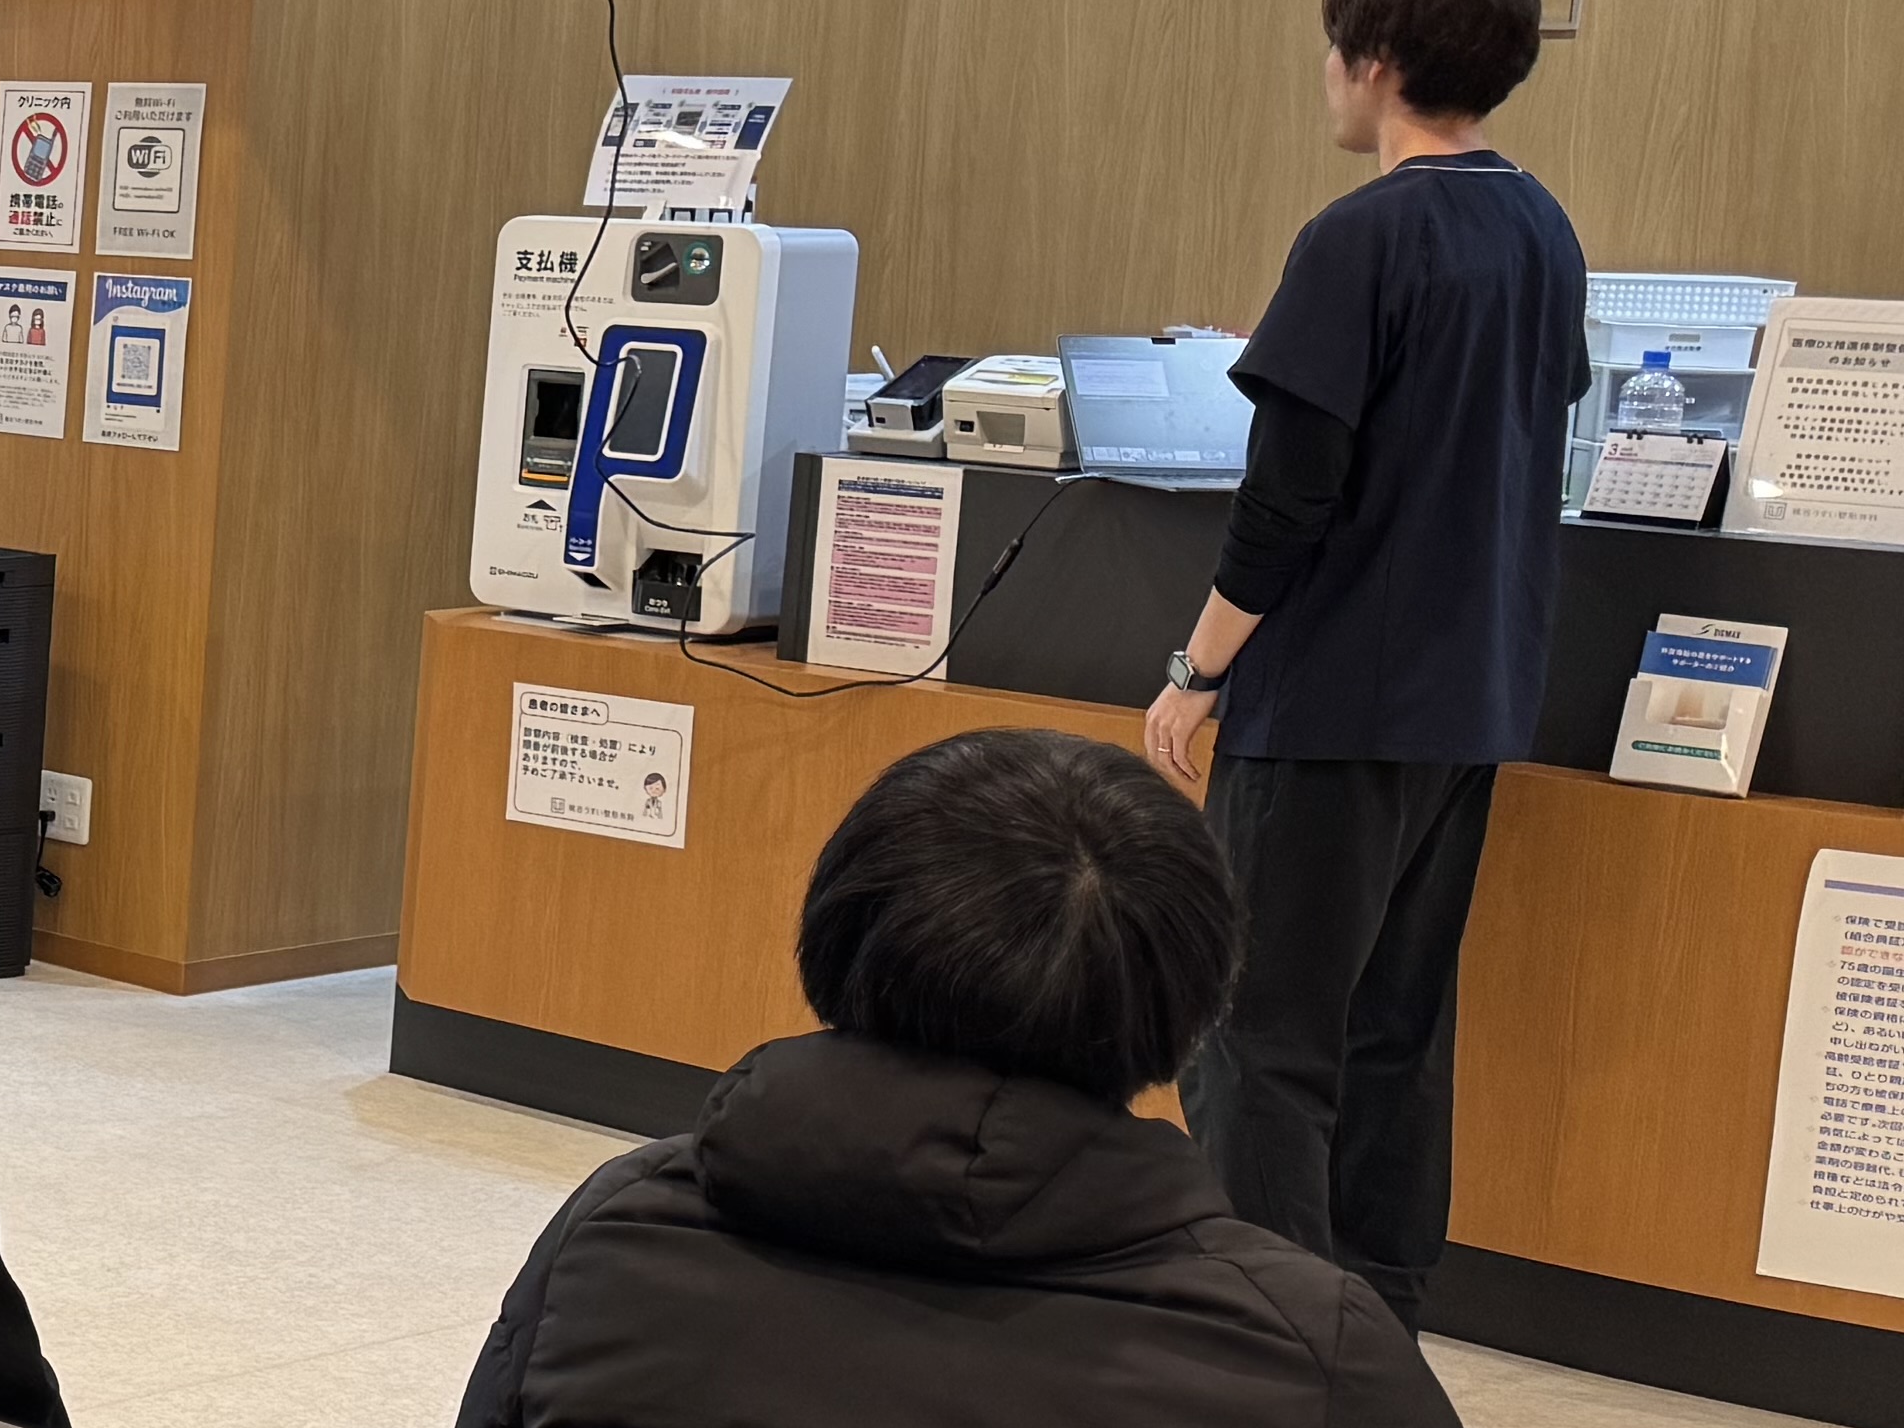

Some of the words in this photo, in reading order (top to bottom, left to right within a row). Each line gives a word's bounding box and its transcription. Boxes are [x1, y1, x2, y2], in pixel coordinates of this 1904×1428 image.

[18, 95, 72, 110] クリニック内
[9, 193, 64, 210] 携帯電話の
[113, 226, 134, 237] FREE
[162, 228, 176, 239] OK
[515, 249, 578, 274] 支払機
[514, 274, 544, 283] Payment
[106, 278, 177, 306] Instagram
[1828, 355, 1891, 368] のお知らせ
[1608, 443, 1619, 456] 3
[528, 698, 601, 717] 患者の皆さまへ
[1837, 976, 1904, 993] の認定を受
[1832, 1022, 1904, 1039] ど)、あるい
[1825, 1051, 1904, 1070] 高齢受給者証
[1826, 1067, 1904, 1085] 証、ひとり親
[1826, 1082, 1904, 1101] ちの方も被保
[1821, 1112, 1904, 1132] 必要です。次回
